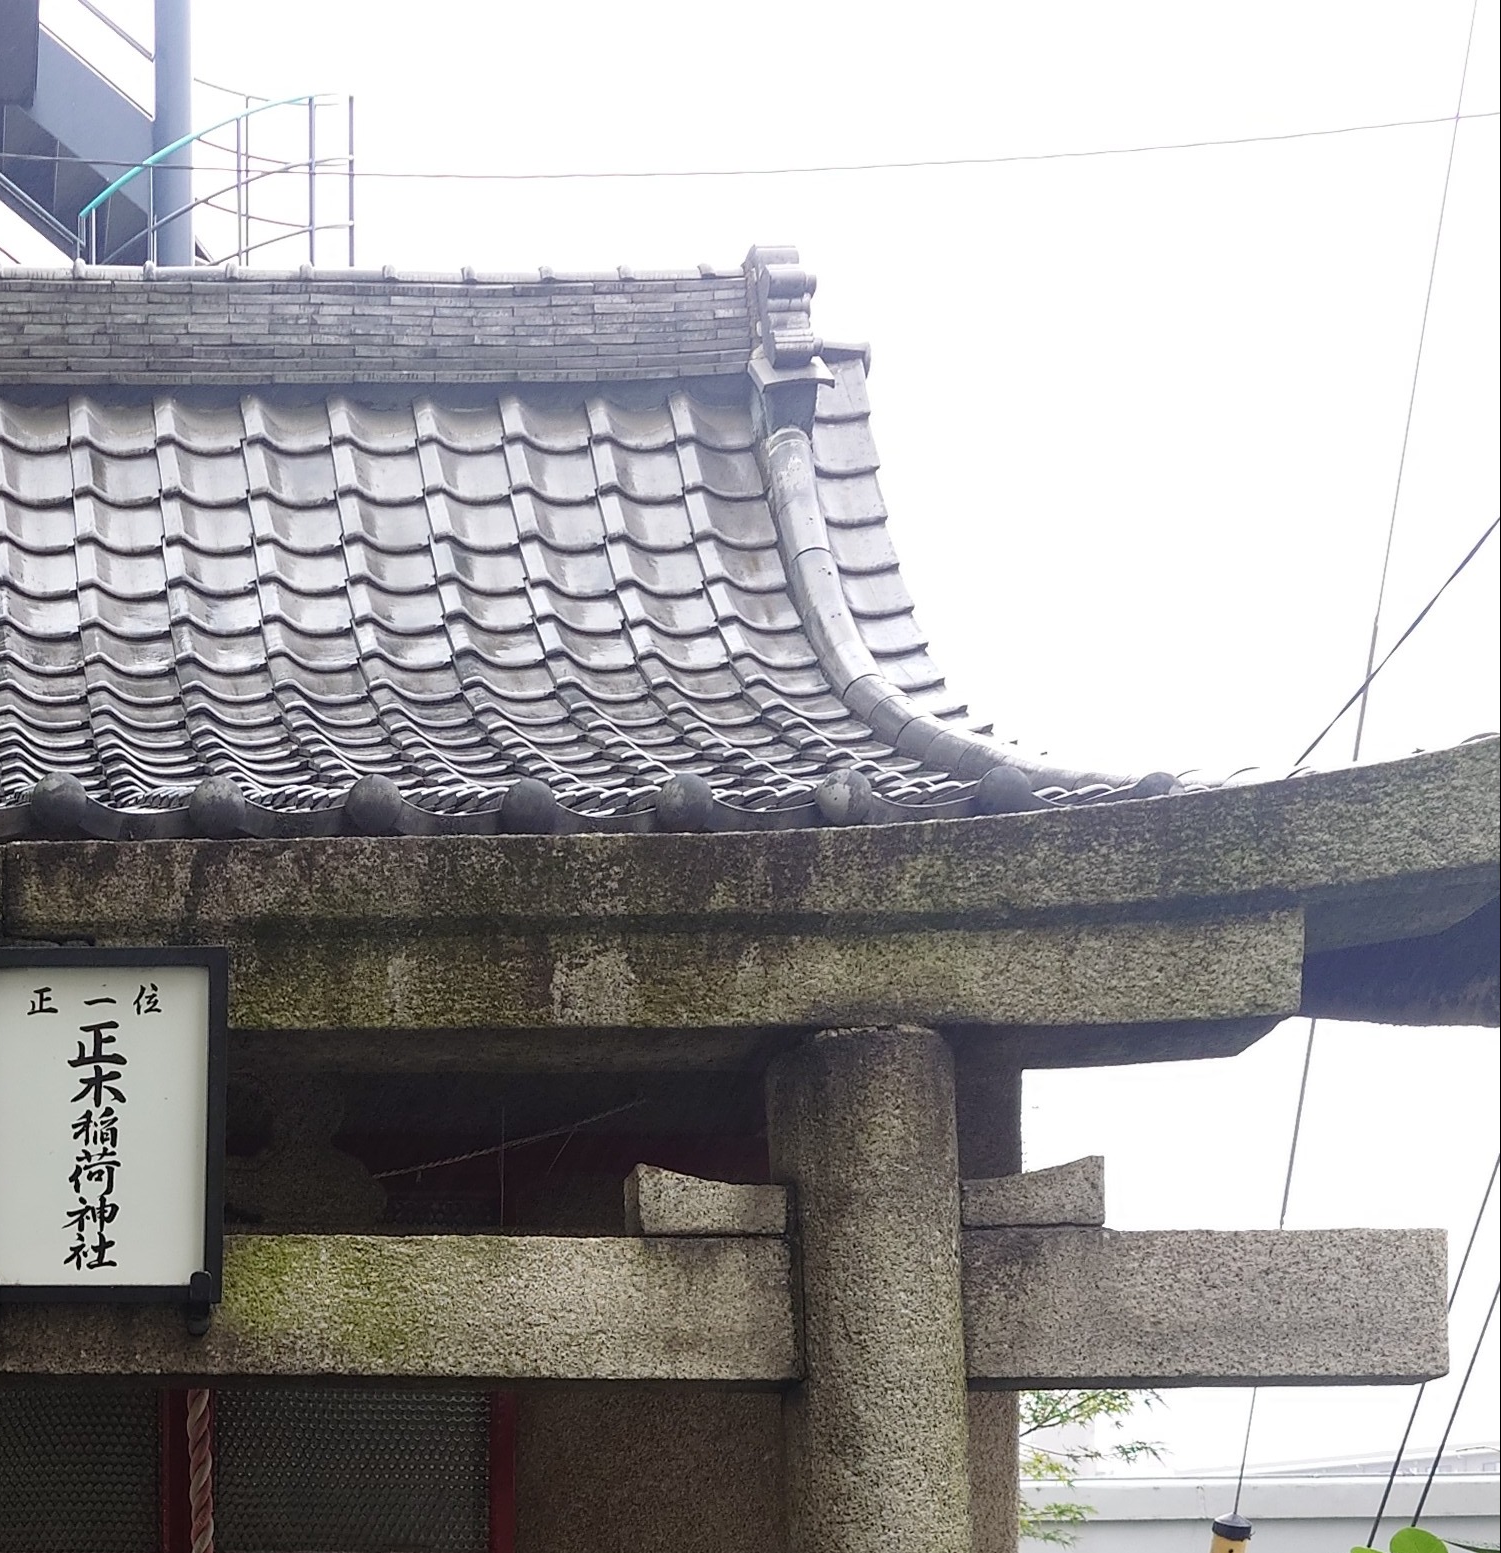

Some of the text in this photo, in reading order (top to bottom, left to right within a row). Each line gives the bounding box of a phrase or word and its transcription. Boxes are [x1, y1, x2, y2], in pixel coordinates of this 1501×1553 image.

[26, 982, 163, 1016] 正一位
[61, 1020, 128, 1271] 正木稲荷神社
